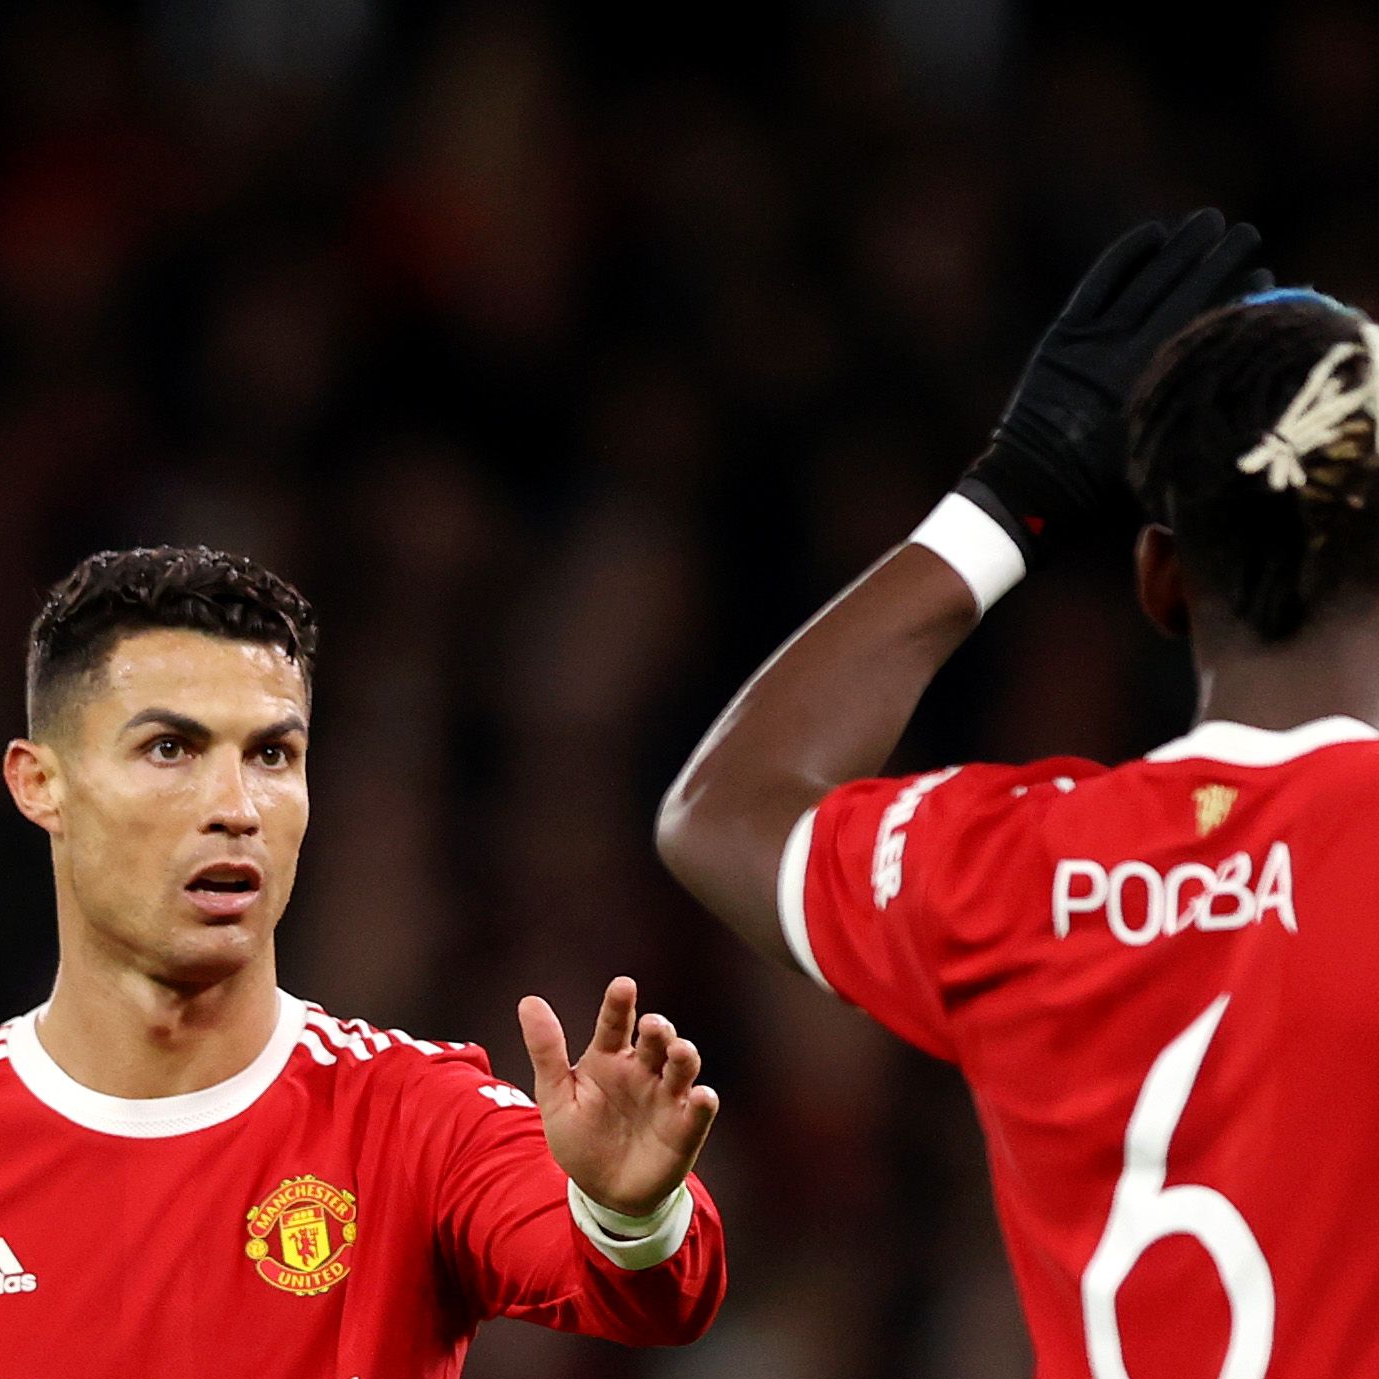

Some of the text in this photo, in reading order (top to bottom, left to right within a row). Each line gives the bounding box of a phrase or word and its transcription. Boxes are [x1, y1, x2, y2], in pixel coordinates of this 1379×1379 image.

[1052, 840, 1299, 946] POGBA
[256, 1184, 349, 1230] MANCHESTER
[277, 1262, 344, 1288] UNITED
